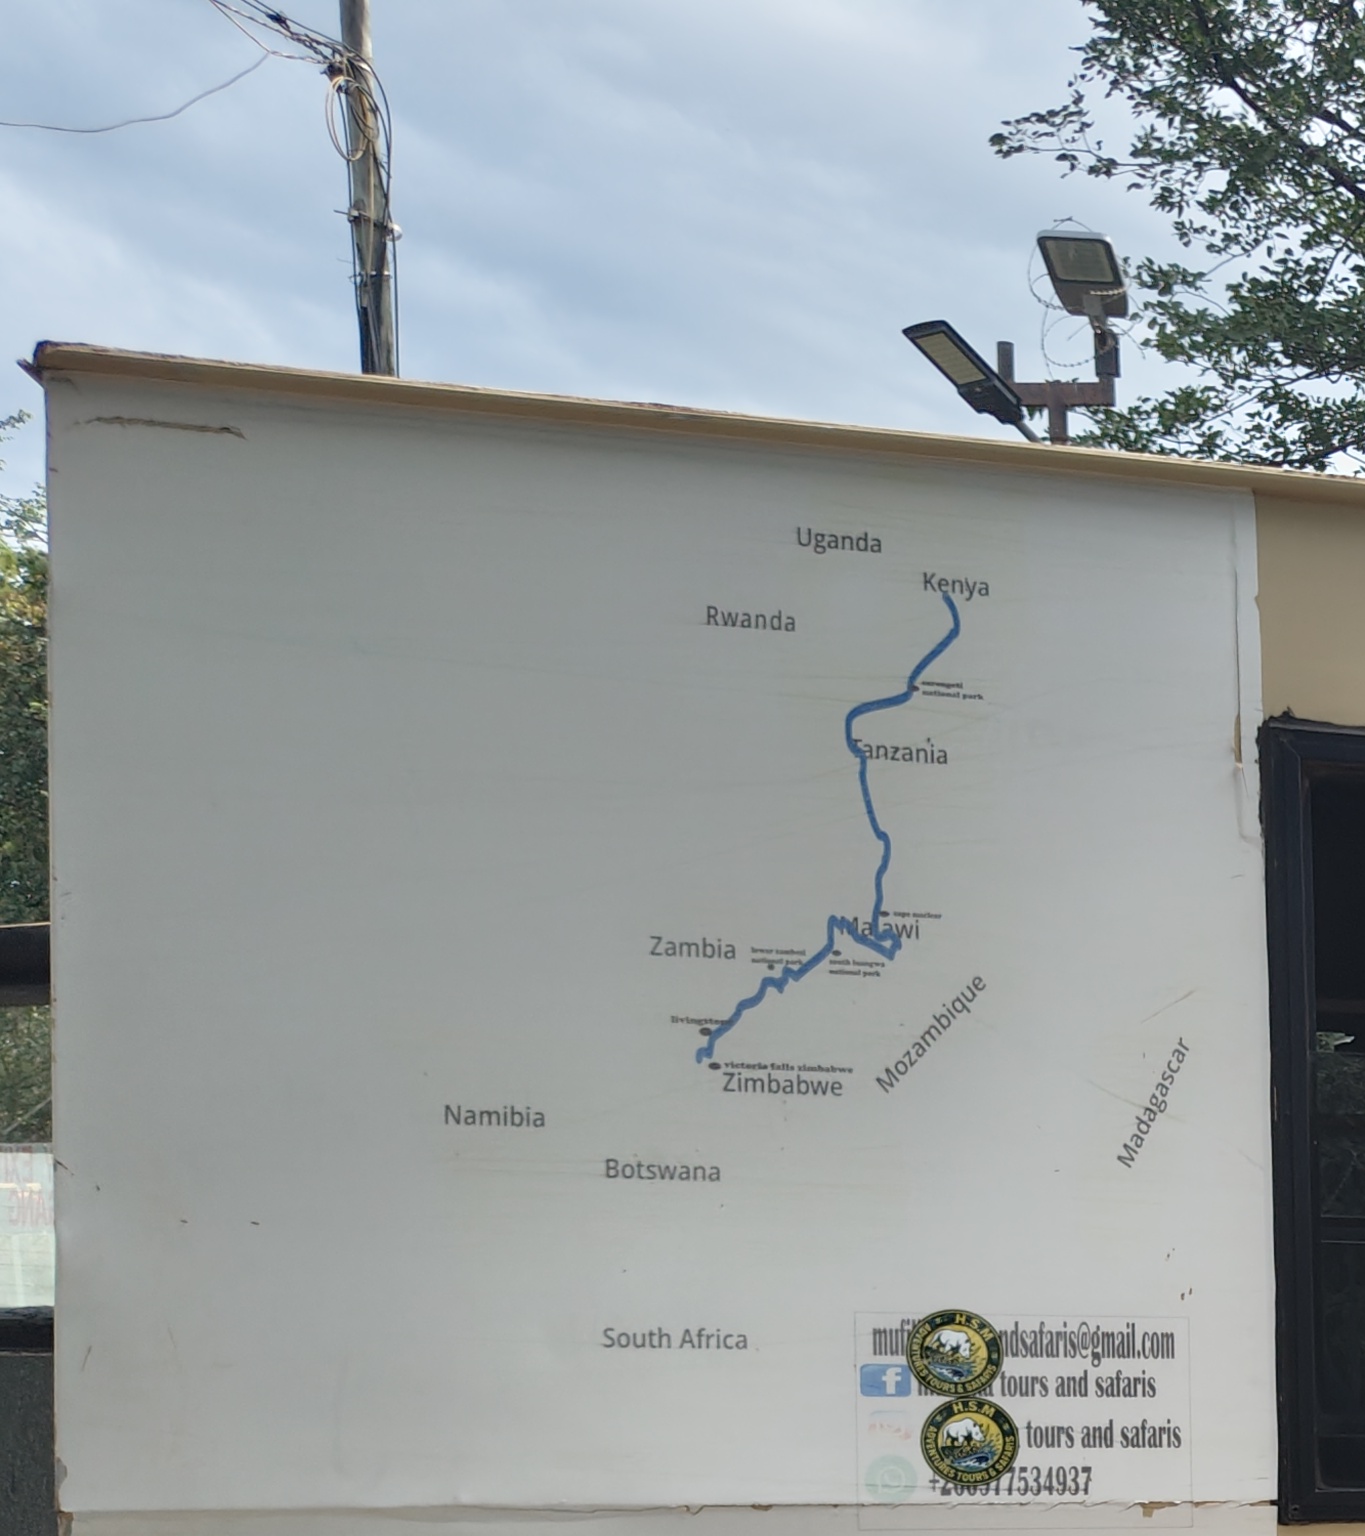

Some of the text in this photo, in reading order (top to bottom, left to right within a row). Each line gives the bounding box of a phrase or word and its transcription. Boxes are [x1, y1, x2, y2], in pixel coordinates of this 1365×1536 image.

[796, 526, 883, 554] Uganda
[922, 572, 990, 601] Kenya
[705, 606, 796, 633] Rwanda
[922, 690, 984, 701] national park
[840, 916, 920, 940] Maawi
[649, 936, 736, 960] Zambia
[875, 974, 987, 1094] Mozambique
[724, 1061, 854, 1074] victoria falls zimbabwe
[722, 1072, 843, 1096] Zimbabwe
[1116, 1035, 1191, 1170] Madagascar
[443, 1104, 546, 1130] Namibia
[604, 1158, 721, 1183] Botswana
[602, 1325, 749, 1352] South Africa
[926, 1374, 956, 1394] TOURS
[1000, 1370, 1049, 1398] tours
[1055, 1370, 1089, 1399] and
[1095, 1370, 1157, 1399] safaris
[1026, 1419, 1182, 1450] tours and safaris
[957, 1471, 989, 1482] TOURS
